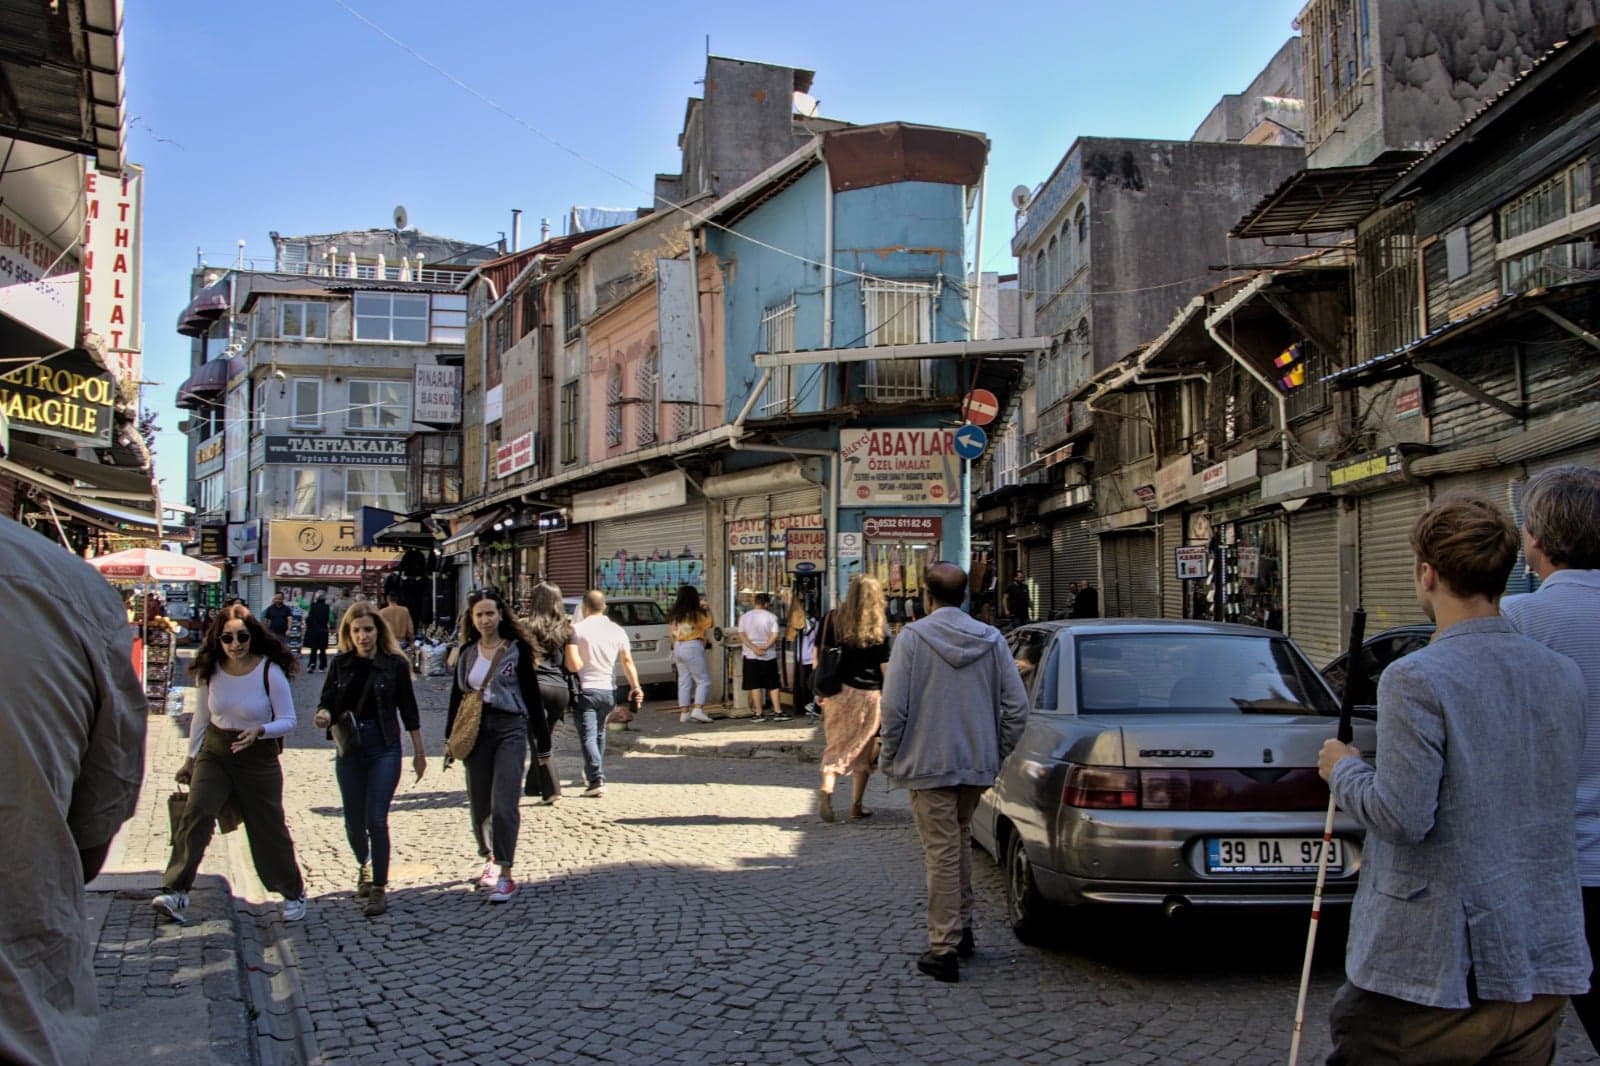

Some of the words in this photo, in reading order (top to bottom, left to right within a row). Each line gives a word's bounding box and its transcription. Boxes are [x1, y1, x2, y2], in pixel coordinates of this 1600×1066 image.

[0, 363, 114, 406] ETROPOL
[868, 431, 954, 456] ABAYLAR
[868, 458, 892, 470] ÖZEL
[276, 562, 311, 576] AS
[1222, 841, 1246, 864] 39
[1259, 841, 1283, 864] DA
